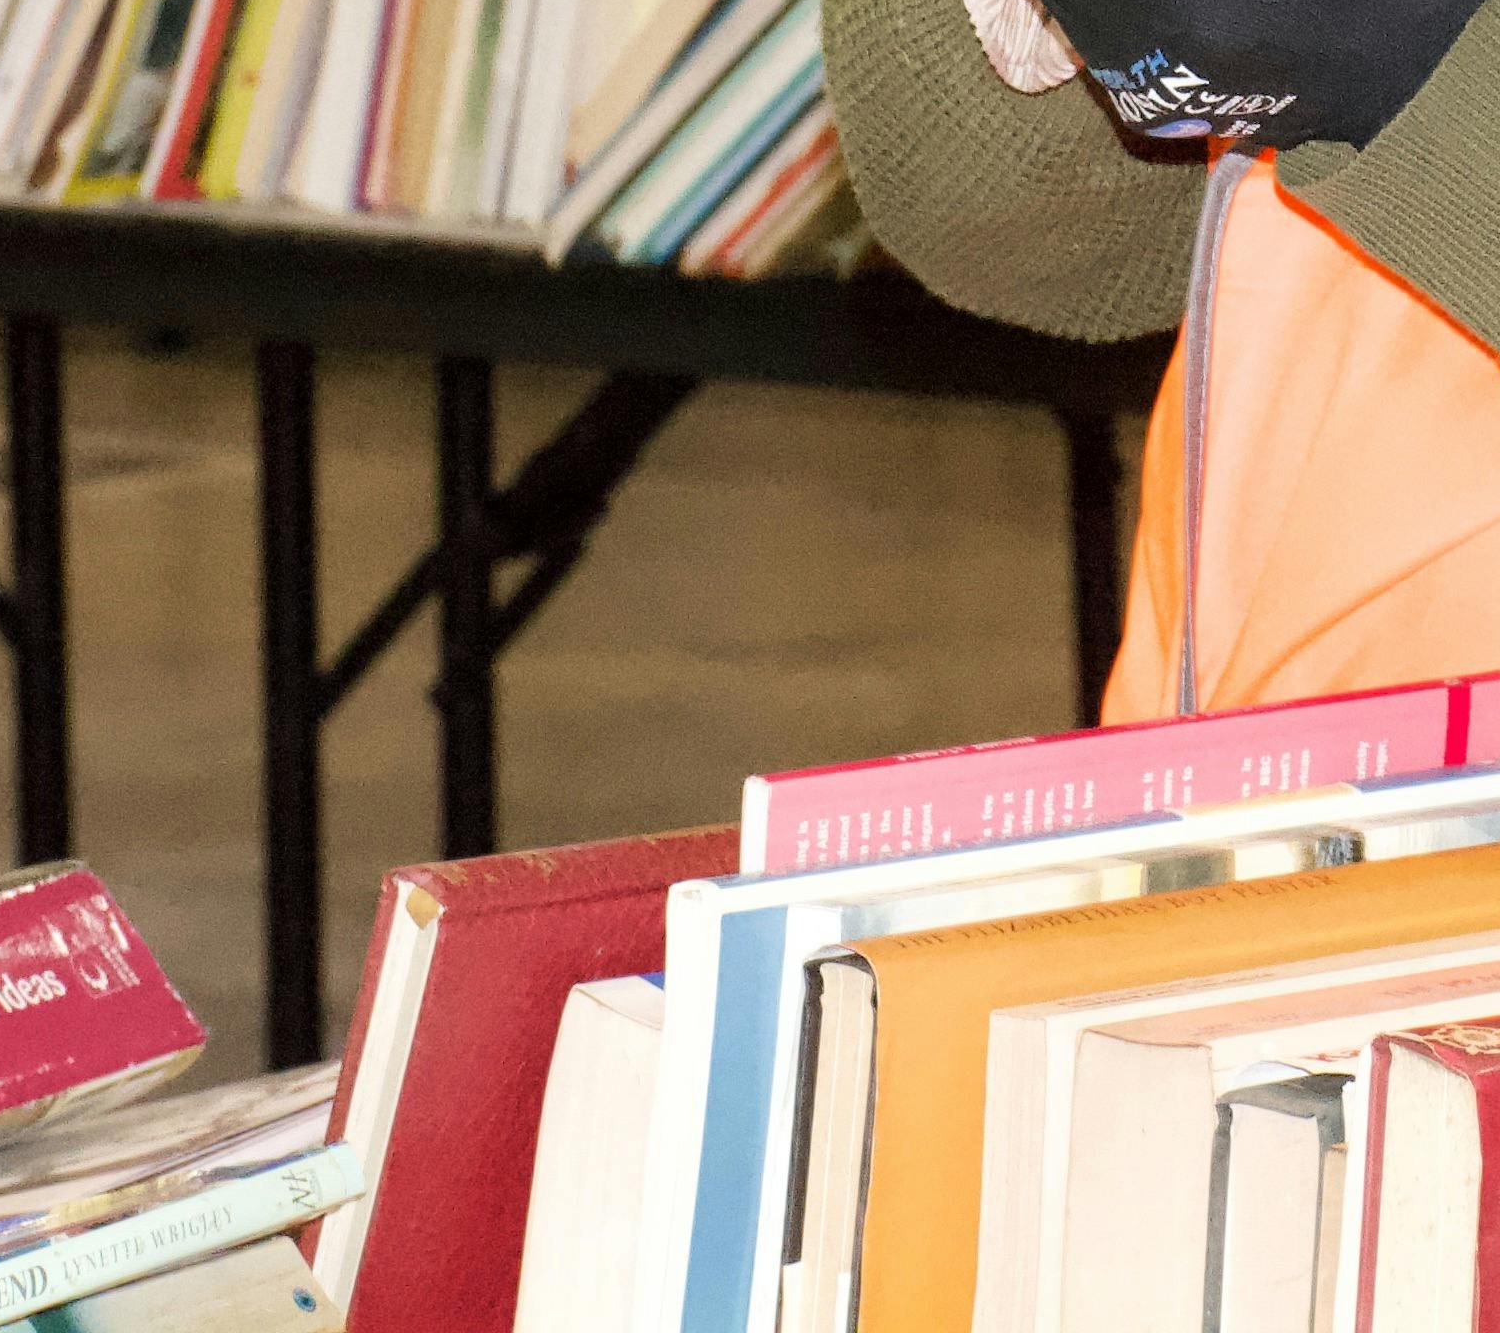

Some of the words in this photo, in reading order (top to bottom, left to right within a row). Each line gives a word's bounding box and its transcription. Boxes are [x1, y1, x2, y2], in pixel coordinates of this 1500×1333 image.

[1181, 765, 1192, 780] to
[1260, 755, 1272, 786] BBC
[981, 794, 993, 820] few
[1064, 782, 1075, 809] and
[1083, 779, 1094, 808] how
[816, 818, 828, 849] ABC
[858, 812, 870, 839] and
[880, 809, 891, 833] the
[902, 805, 914, 836] your
[60, 1237, 145, 1281] LYNETTE
